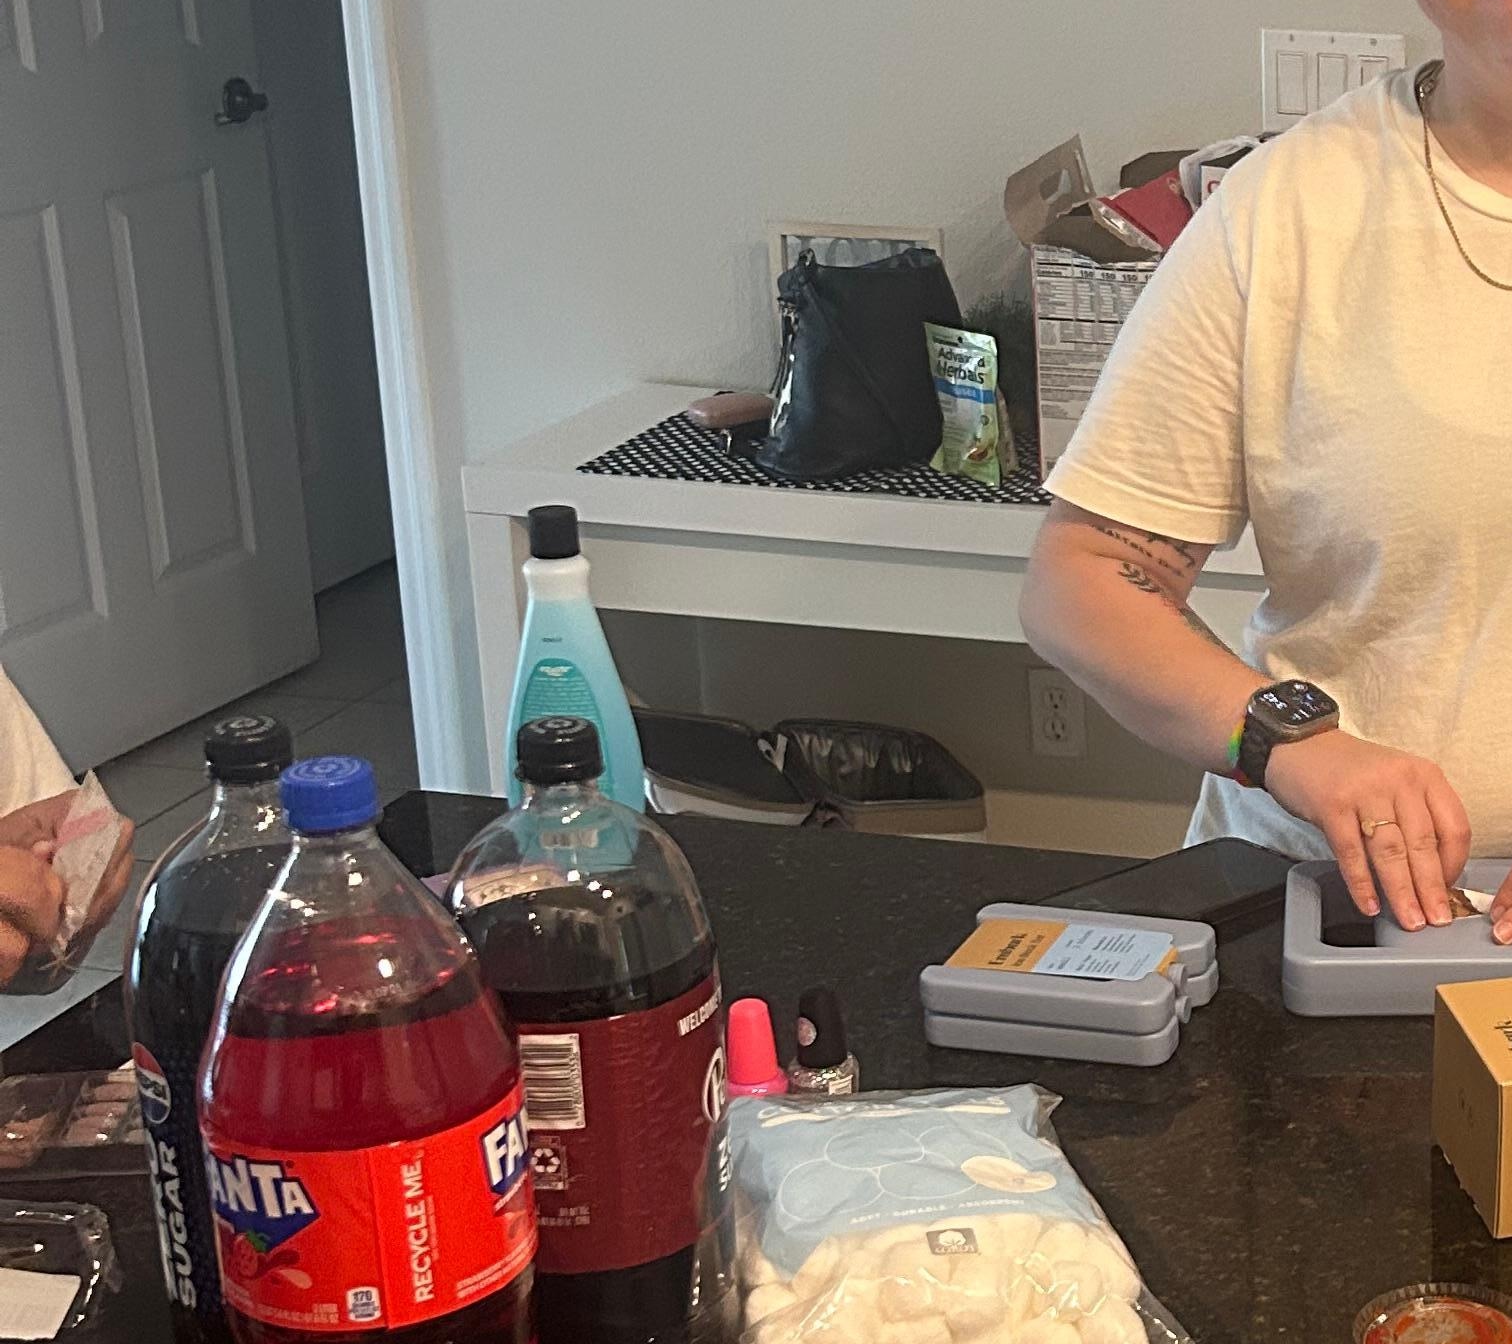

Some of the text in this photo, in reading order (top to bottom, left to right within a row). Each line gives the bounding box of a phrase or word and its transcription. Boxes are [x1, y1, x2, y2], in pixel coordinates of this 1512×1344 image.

[156, 1139, 198, 1311] SUGAR
[207, 1151, 315, 1219] ANTA
[405, 1199, 435, 1304] RECYCLE
